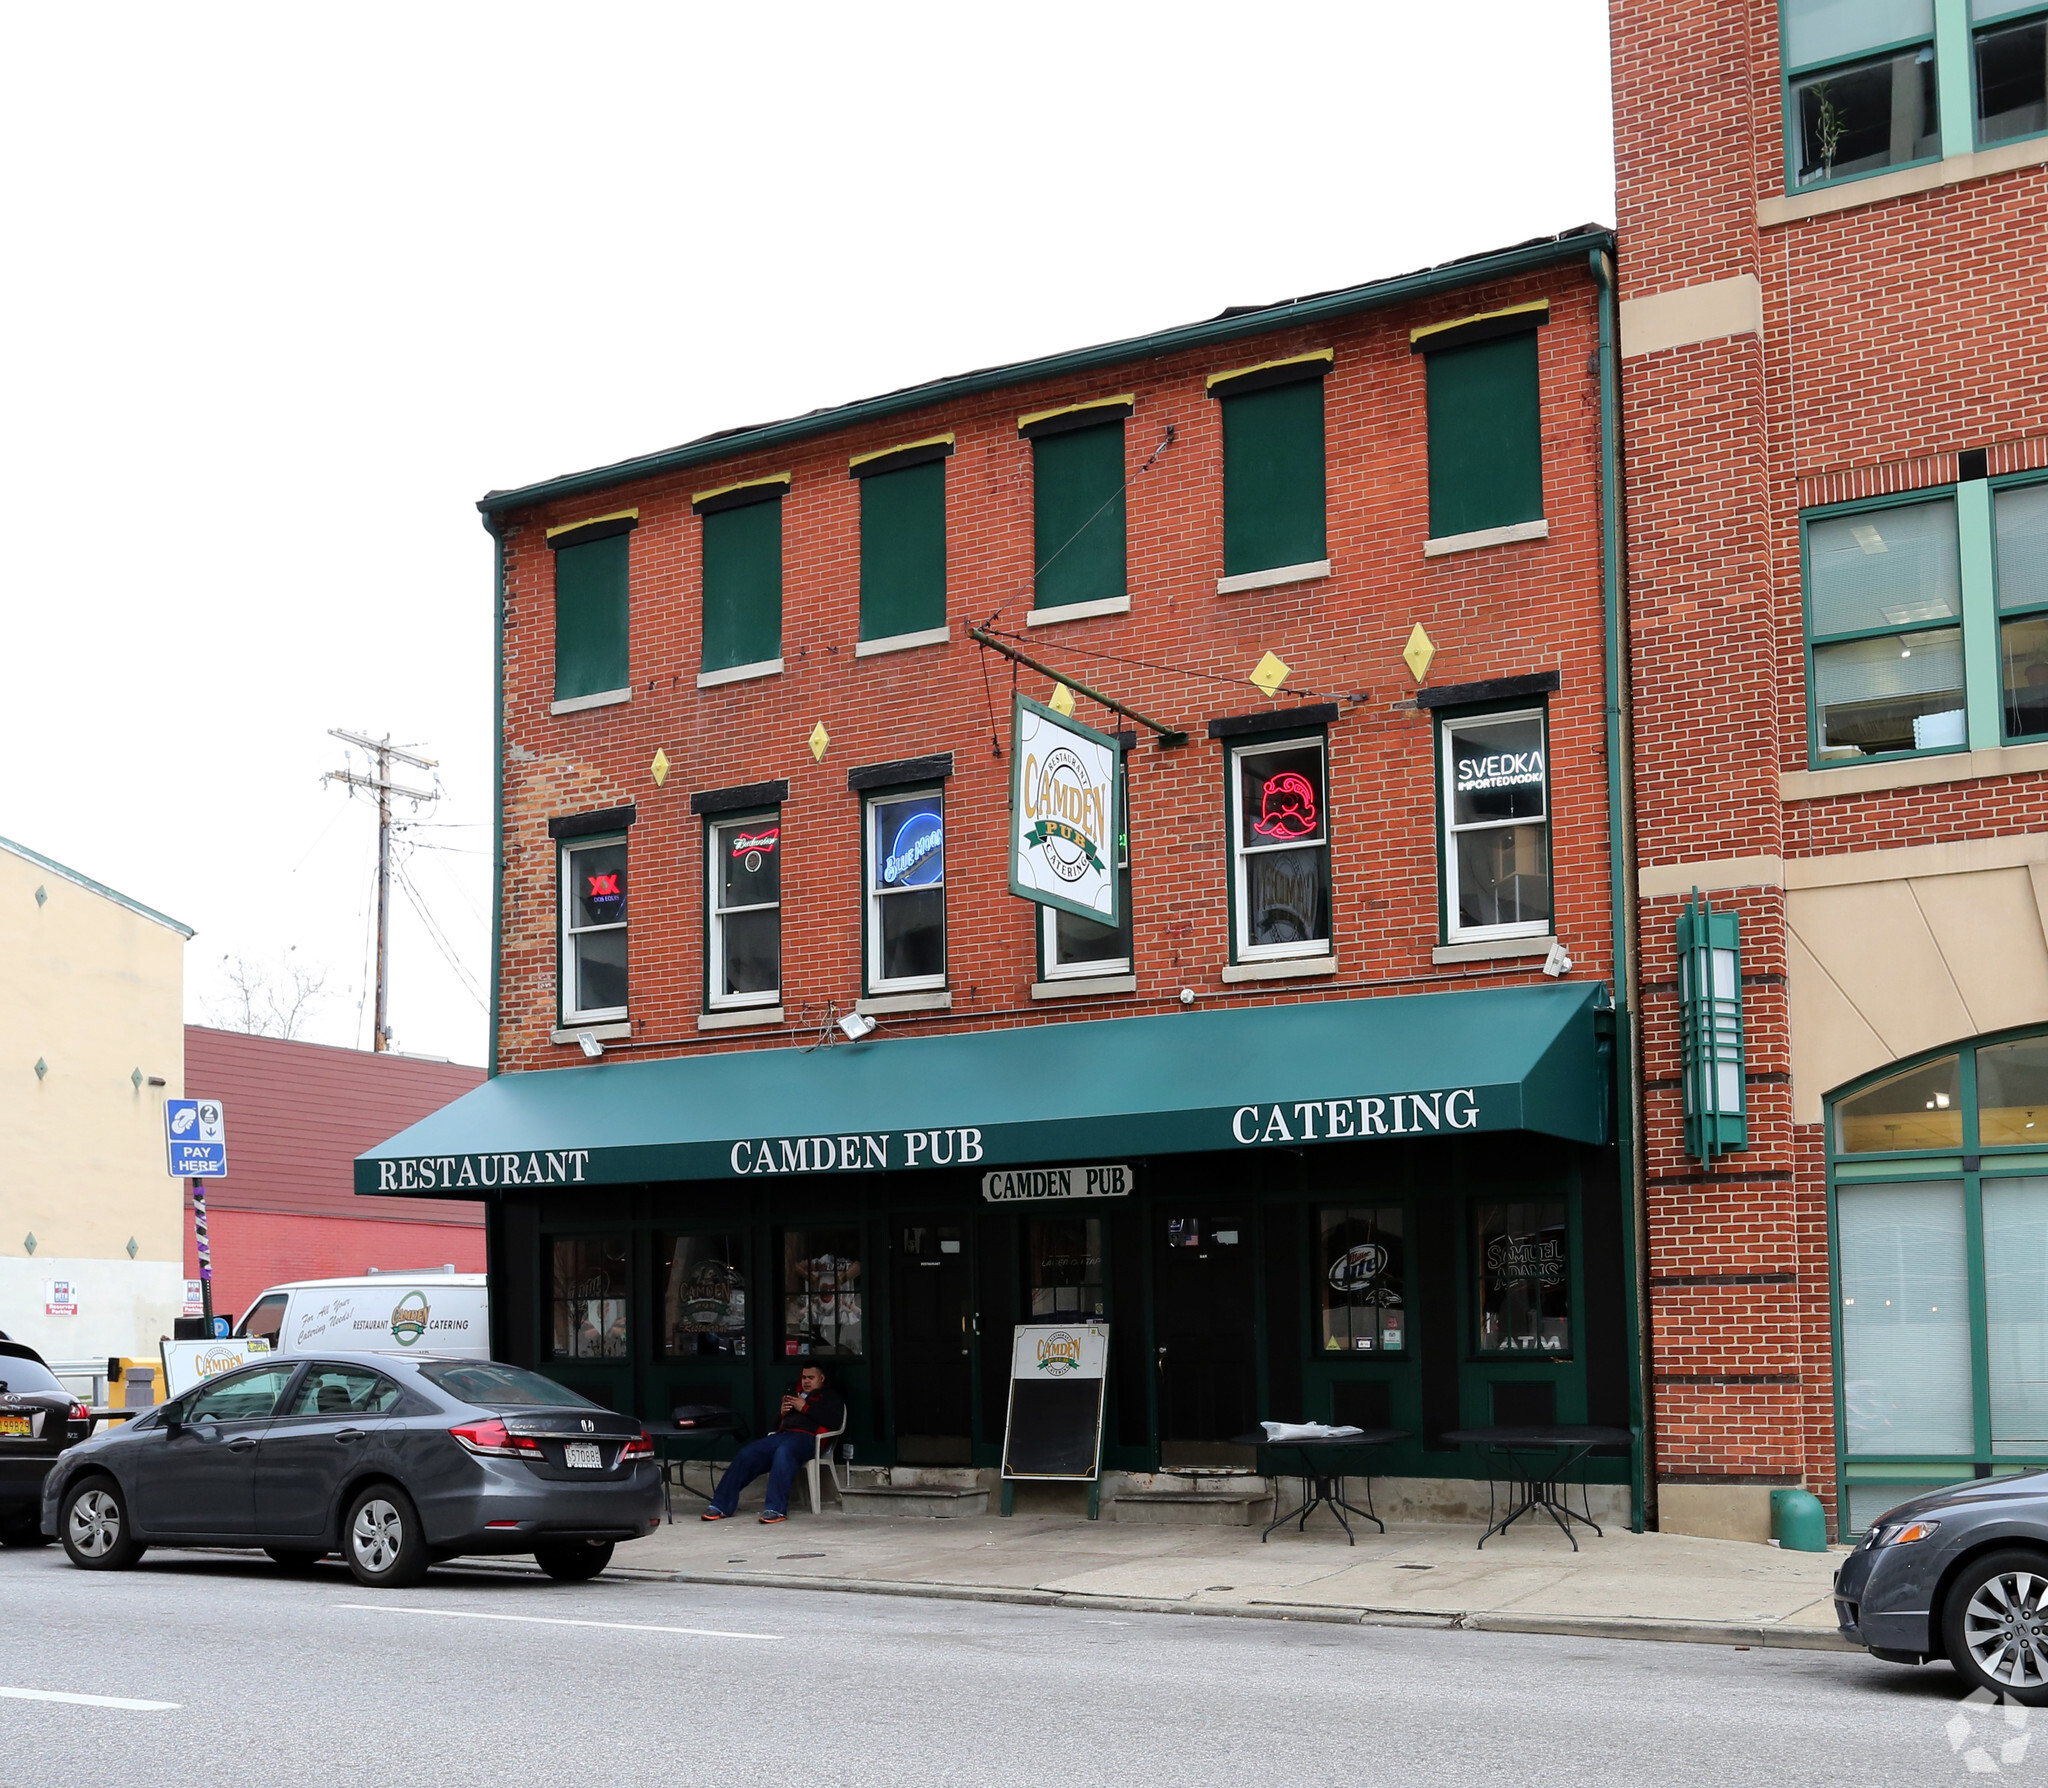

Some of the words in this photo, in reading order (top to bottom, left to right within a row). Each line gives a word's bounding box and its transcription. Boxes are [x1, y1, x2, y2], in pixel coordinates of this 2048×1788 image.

[1048, 752, 1088, 786] RESTAURANT
[1458, 751, 1543, 780] SVEDKA
[1025, 753, 1106, 850] CAMDEN
[1045, 821, 1086, 848] PUB
[1046, 843, 1088, 878] CATERING
[204, 1105, 214, 1118] 2
[1232, 1088, 1480, 1145] CATERING
[183, 1146, 211, 1158] PAY
[730, 1134, 890, 1175] CAMDEN
[903, 1127, 984, 1167] PUB
[179, 1160, 219, 1172] HERE
[378, 1150, 590, 1191] RESTAURANT
[989, 1170, 1072, 1200] CAMDEN
[1086, 1167, 1125, 1195] PUB
[680, 1282, 732, 1303] CAMDEN
[301, 1313, 314, 1328] For
[332, 1299, 351, 1314] Your
[353, 1320, 389, 1330] RESTAURANT
[391, 1304, 431, 1326] CAMDEN
[429, 1319, 469, 1330] CATERING
[297, 1324, 326, 1345] Catering
[1037, 1336, 1081, 1361] CAMDEN
[195, 1352, 244, 1377] CAMDEN
